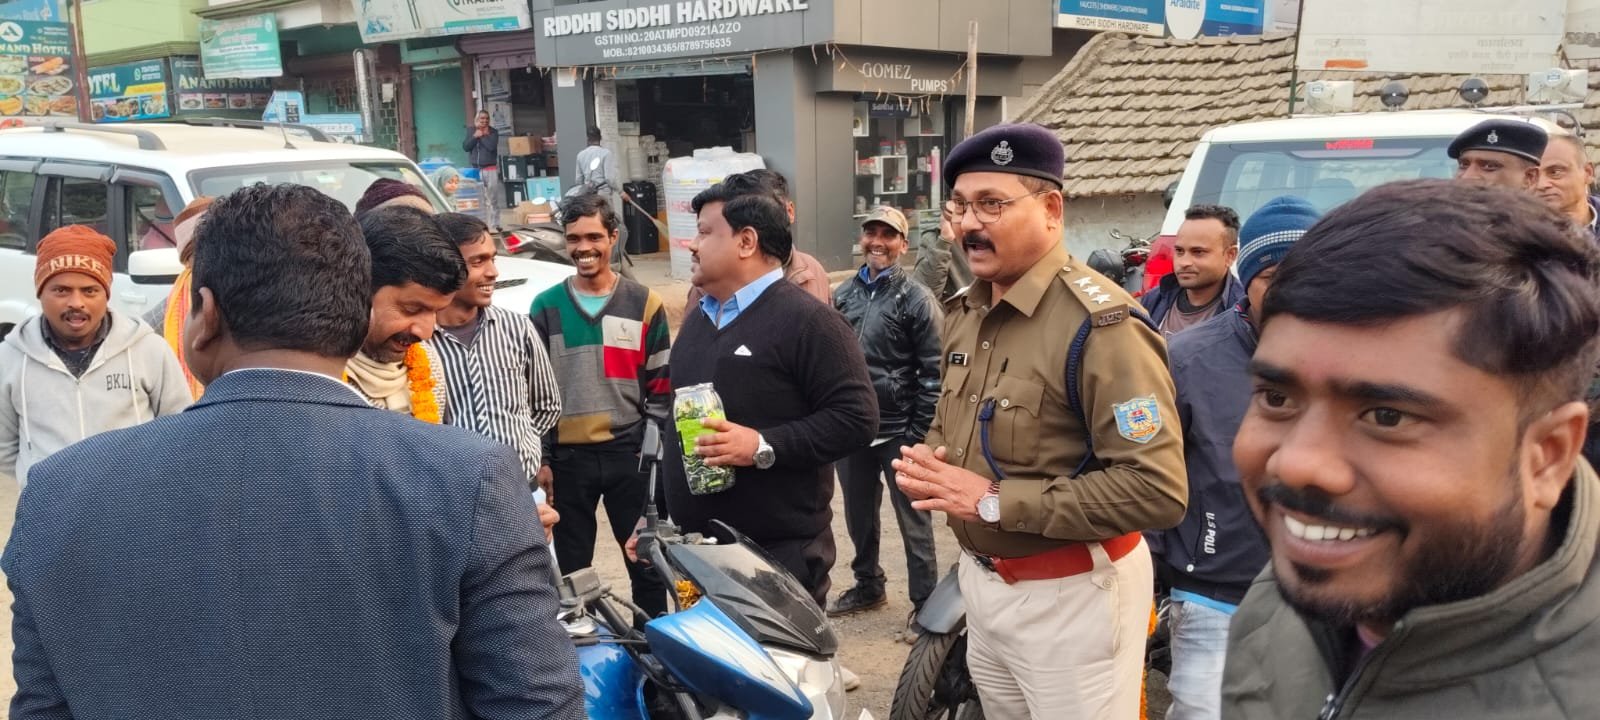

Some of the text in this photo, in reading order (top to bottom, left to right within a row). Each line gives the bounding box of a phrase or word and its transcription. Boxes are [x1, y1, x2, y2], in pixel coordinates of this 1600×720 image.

[543, 12, 602, 37] RIDDHI
[606, 4, 671, 31] SIDDHI
[594, 34, 624, 46] GSTIN
[862, 62, 912, 80] GOMEZ
[911, 79, 948, 92] PUMPS
[49, 254, 104, 275] NIKE
[1203, 529, 1216, 555] POLO
